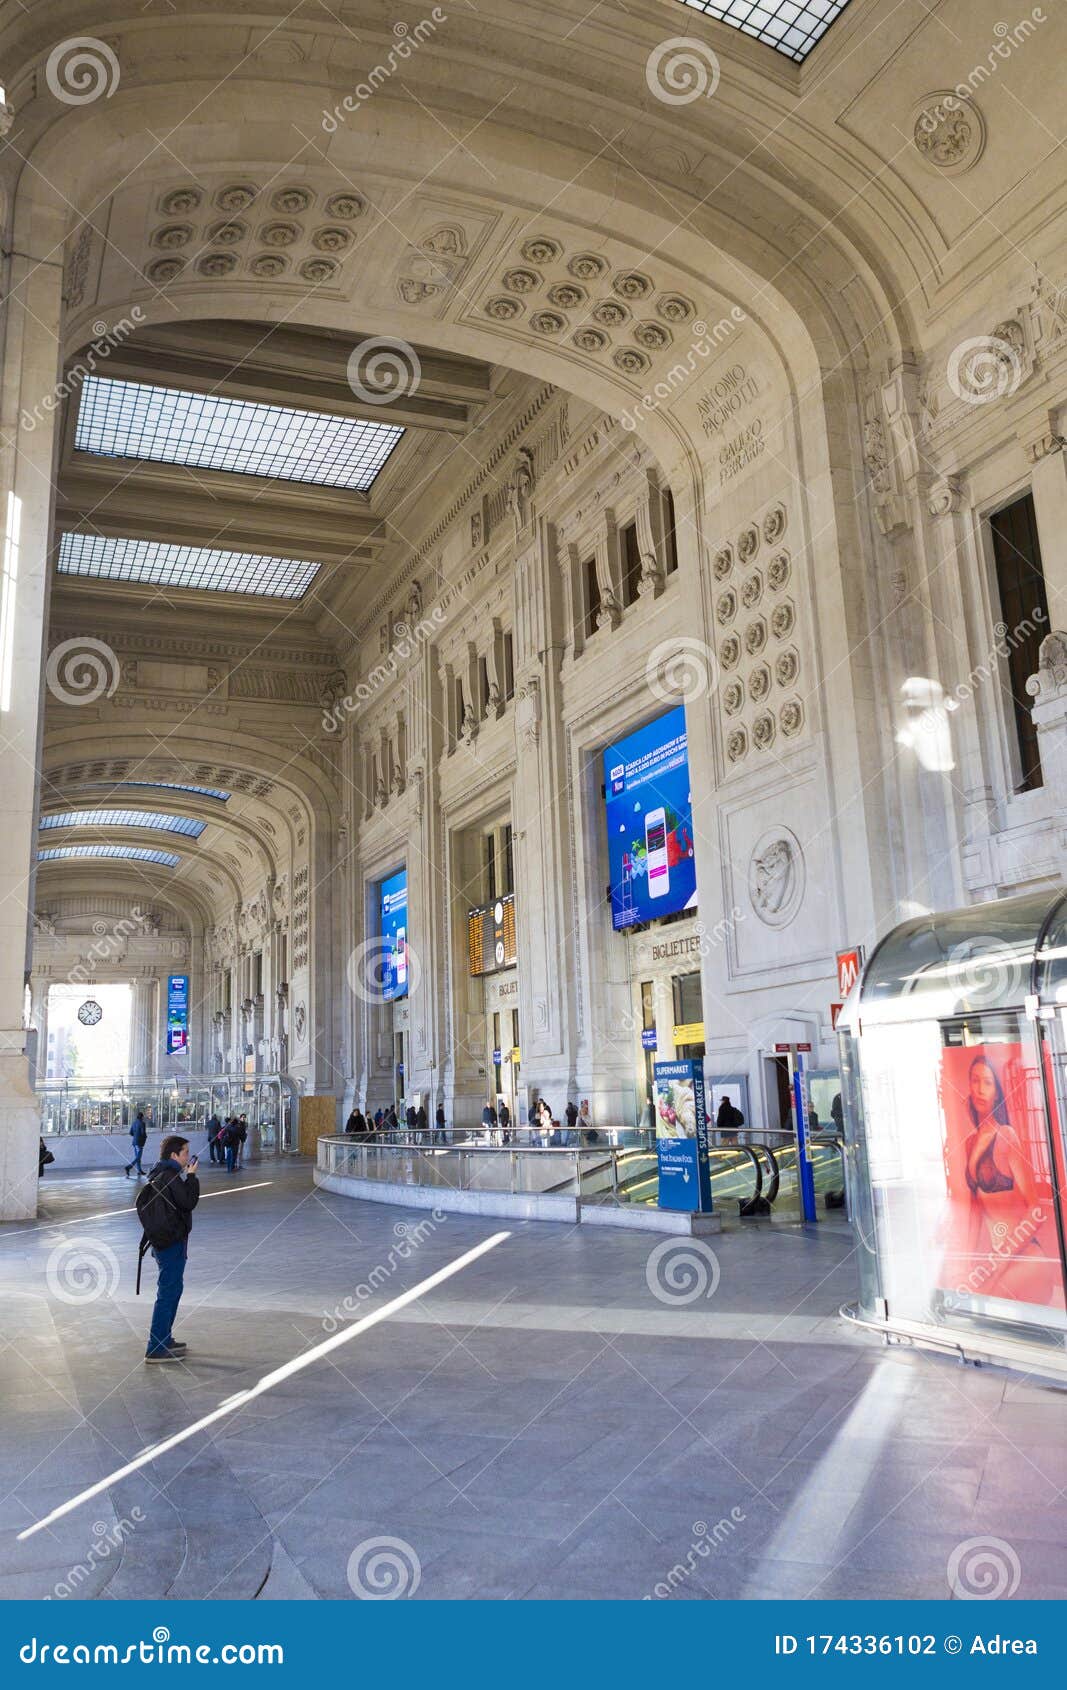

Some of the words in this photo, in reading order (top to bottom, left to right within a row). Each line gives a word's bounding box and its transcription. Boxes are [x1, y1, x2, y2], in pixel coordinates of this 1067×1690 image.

[696, 364, 746, 420] ANTONIO
[656, 1064, 689, 1076] SUPERMARKET
[695, 1079, 707, 1149] SUPERMARKET
